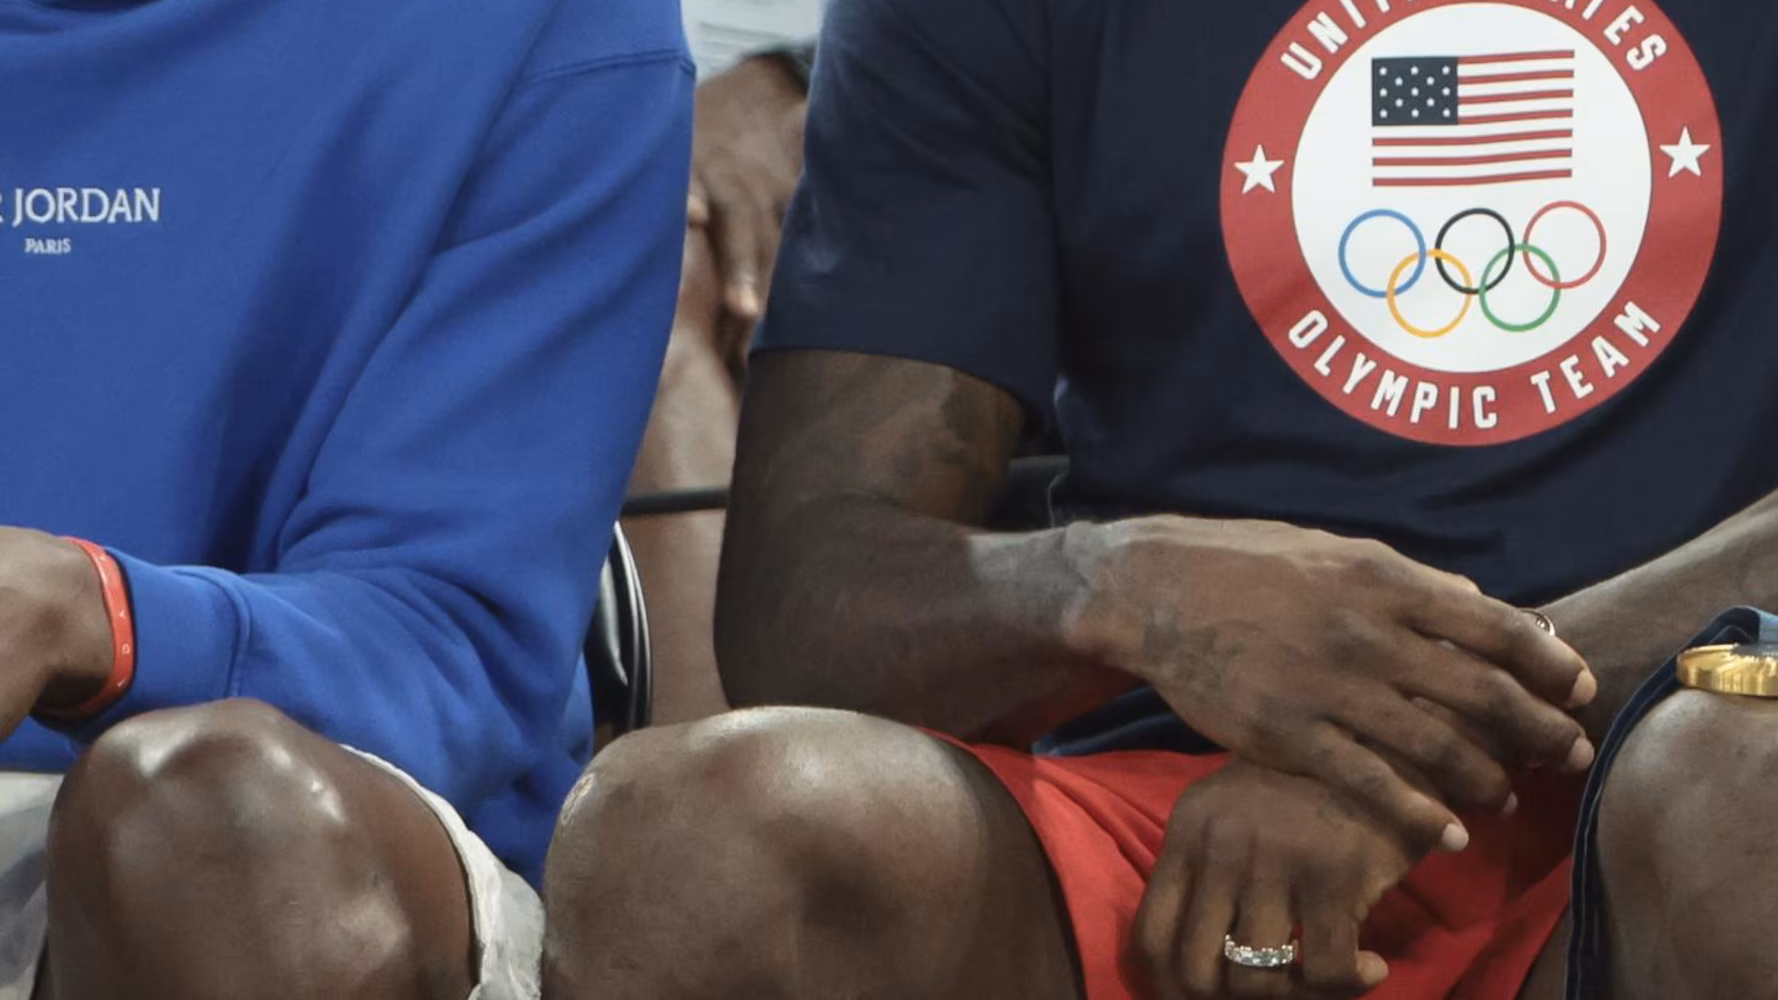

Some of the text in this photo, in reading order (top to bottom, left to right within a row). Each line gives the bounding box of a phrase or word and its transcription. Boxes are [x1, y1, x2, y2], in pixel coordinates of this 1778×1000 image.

[12, 187, 161, 228] JORDAN
[24, 237, 72, 254] PARIS
[1288, 301, 1661, 430] OLYMPIC TEAM
